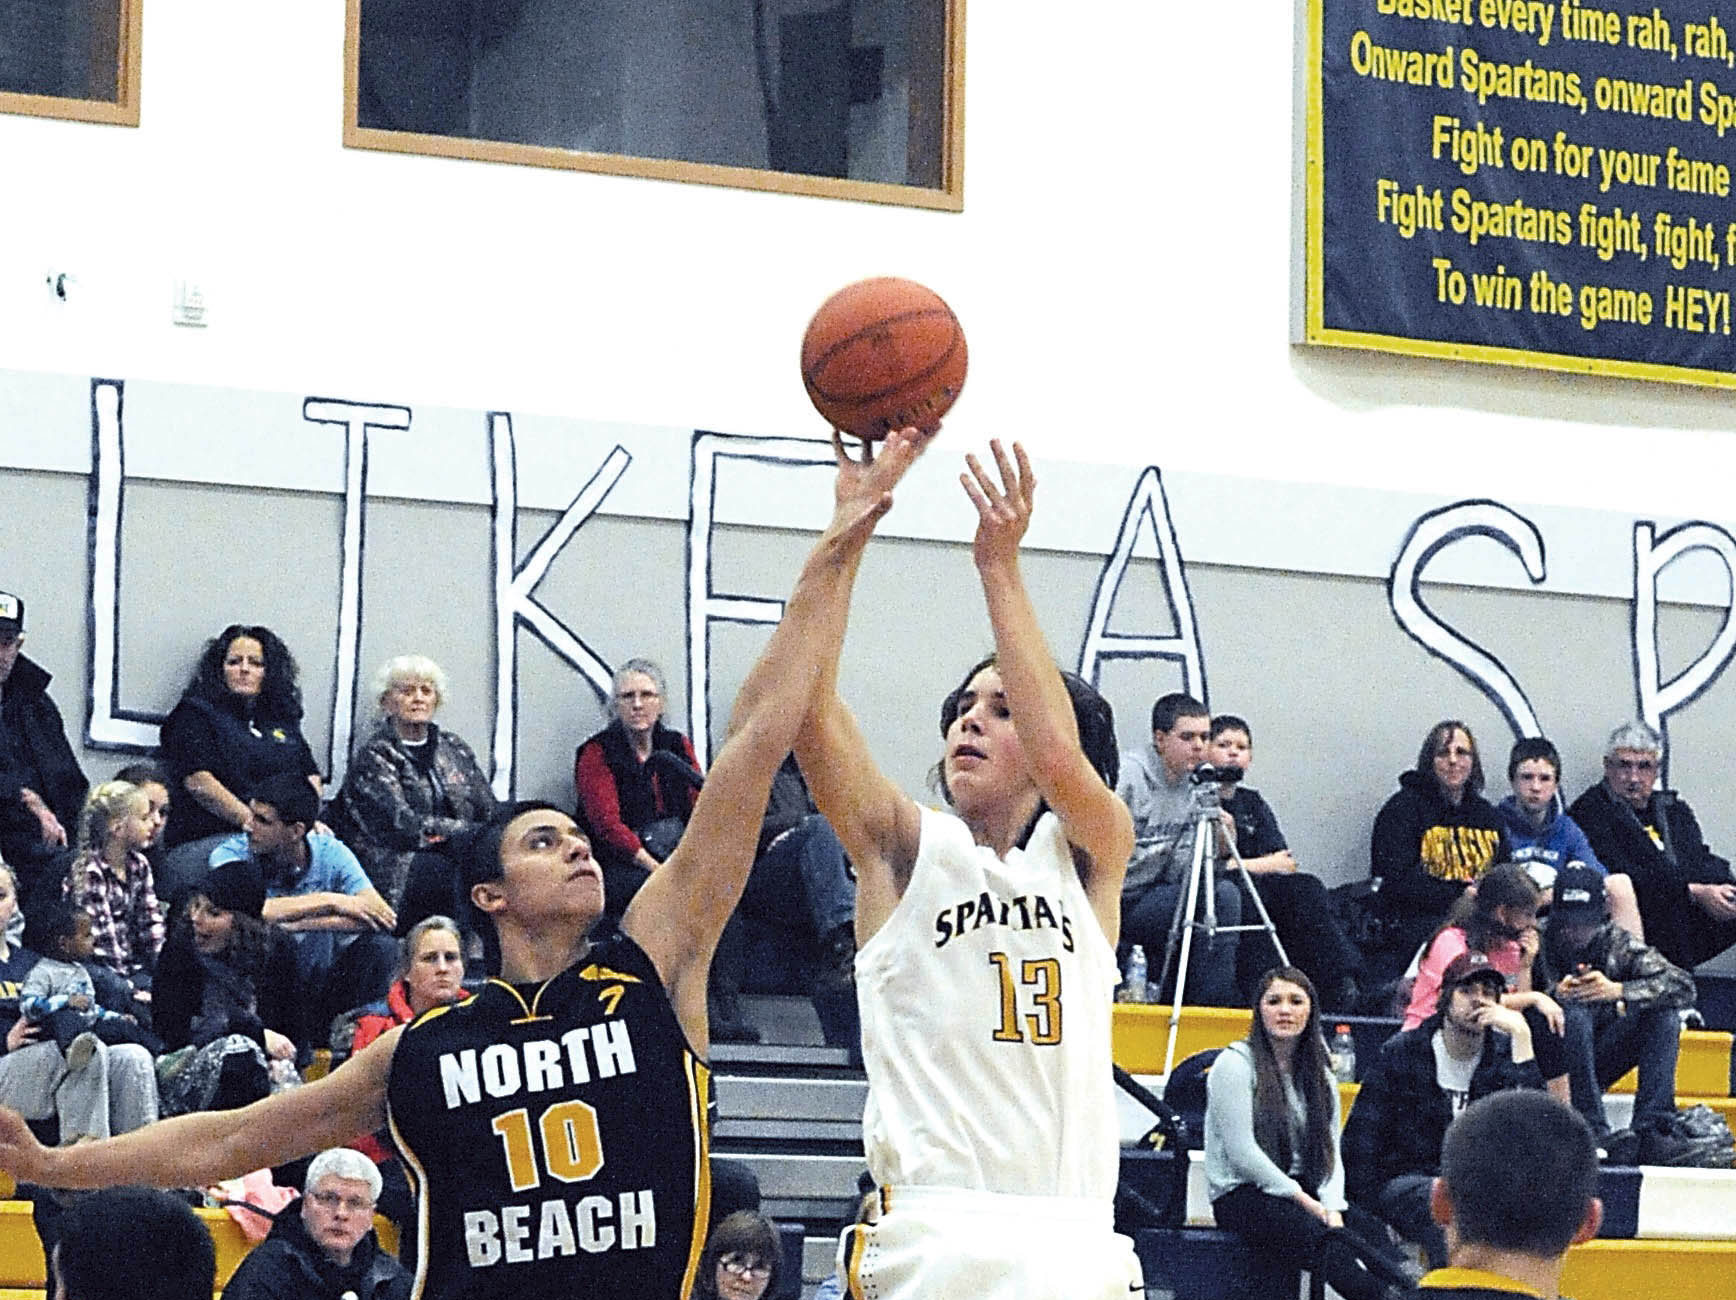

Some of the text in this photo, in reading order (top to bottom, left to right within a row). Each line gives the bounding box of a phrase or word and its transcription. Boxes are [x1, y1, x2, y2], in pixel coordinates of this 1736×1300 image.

[1480, 0, 1555, 46] every
[1562, 0, 1621, 45] time
[1627, 8, 1678, 61] rah,
[1685, 16, 1734, 68] rah,
[1350, 31, 1736, 138] Onward Spartans, onward Sp
[1432, 115, 1730, 198] Fight on for your fame
[1377, 179, 1443, 239] Fight
[1451, 188, 1572, 245] Spartans
[1579, 204, 1647, 262] fight,
[1654, 213, 1719, 271] fight,
[1432, 258, 1731, 336] To win the game HEY!
[1077, 465, 1211, 715] A
[1387, 498, 1736, 790] SP
[988, 952, 1062, 1046] 13
[438, 1018, 637, 1110] NORTH
[491, 1099, 604, 1193] 10
[463, 1189, 656, 1268] BEACH
